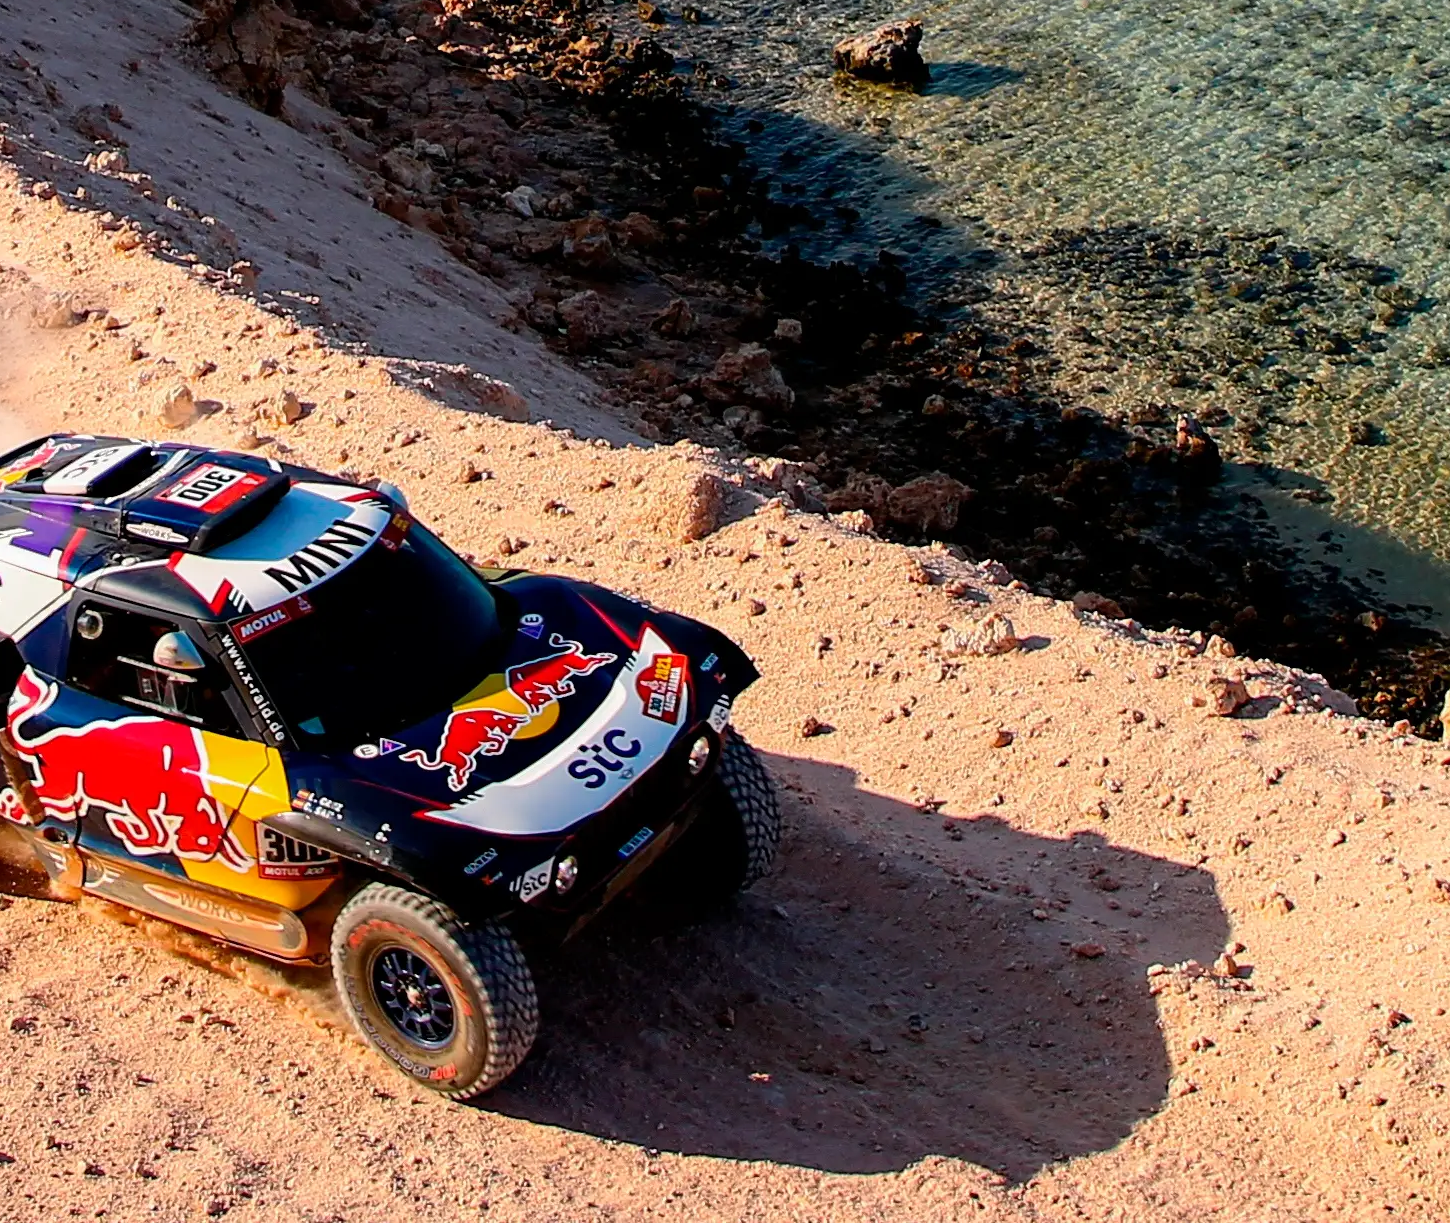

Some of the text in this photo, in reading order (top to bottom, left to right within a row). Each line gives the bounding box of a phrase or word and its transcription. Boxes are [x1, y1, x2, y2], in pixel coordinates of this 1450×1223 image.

[177, 470, 236, 502] 300
[140, 525, 172, 540] WORKS
[263, 519, 378, 594] MINI
[240, 609, 286, 638] MOTUL
[655, 656, 672, 681] 2021
[221, 633, 286, 742] www.x-raid.de
[568, 729, 641, 789] stc
[264, 866, 301, 877] MOTUL
[177, 893, 247, 923] WORKS
